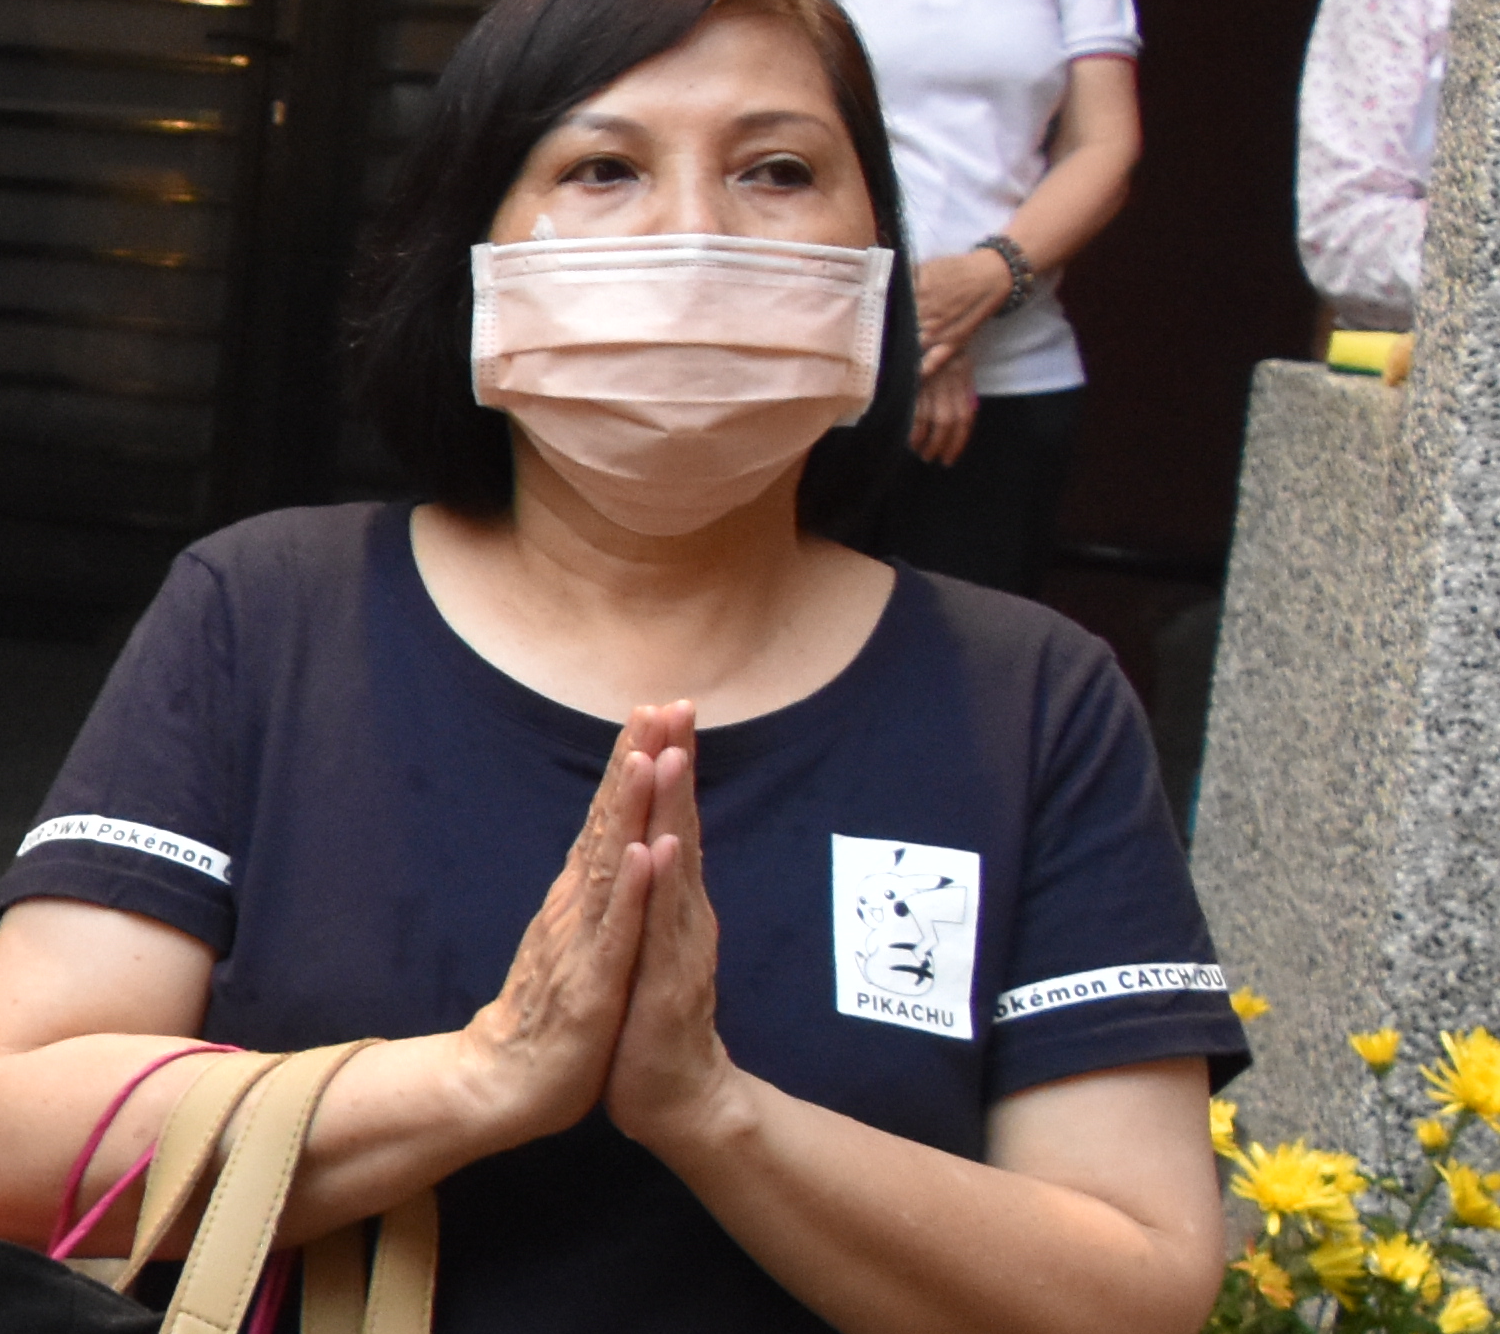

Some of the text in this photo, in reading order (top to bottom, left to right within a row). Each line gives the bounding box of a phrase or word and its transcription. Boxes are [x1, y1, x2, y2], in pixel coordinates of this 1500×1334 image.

[97, 823, 215, 871] Pokémon
[856, 991, 955, 1028] PIKACHU
[996, 979, 1108, 1017] okémon
